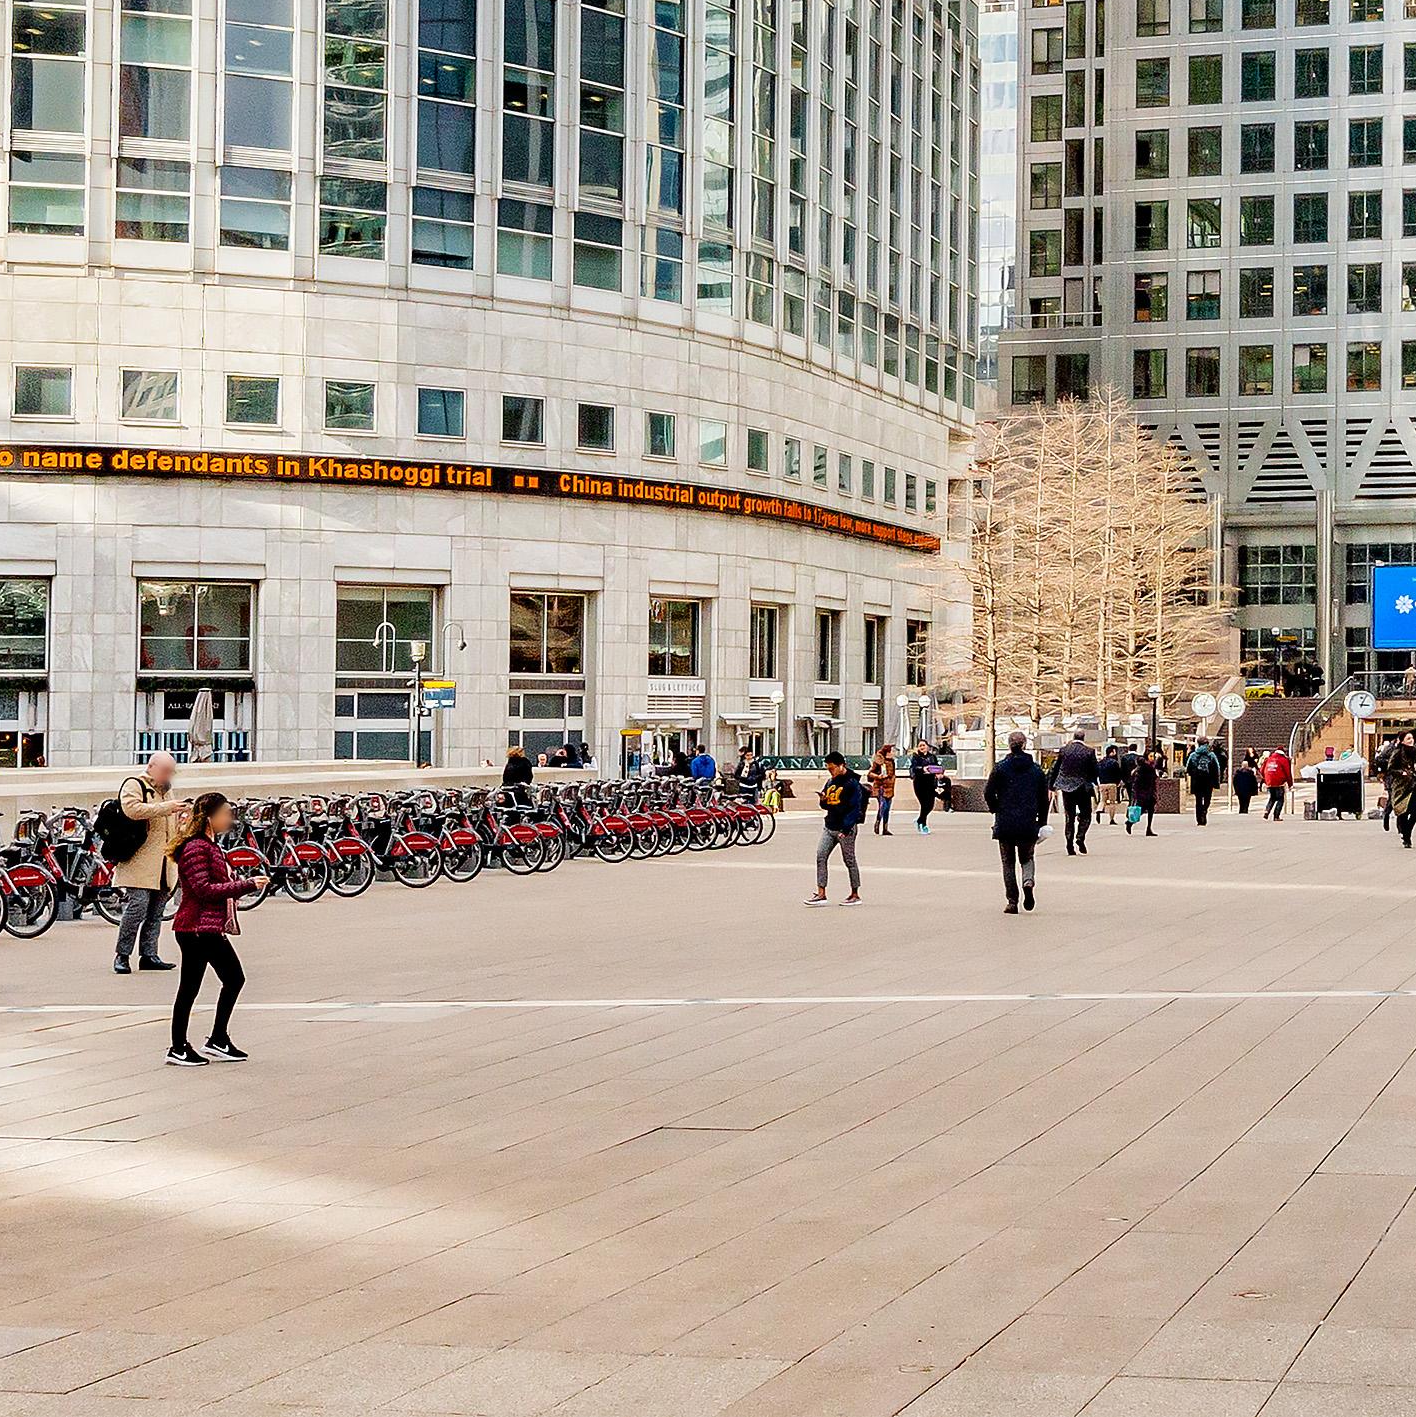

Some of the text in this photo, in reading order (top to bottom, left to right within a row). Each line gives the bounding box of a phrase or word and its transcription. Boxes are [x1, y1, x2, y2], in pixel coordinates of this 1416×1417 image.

[22, 451, 102, 469] name
[112, 450, 269, 476] defendants
[277, 456, 300, 477] in
[309, 458, 440, 487] Khashoggi
[447, 466, 492, 486] trial
[560, 474, 612, 496] China
[619, 479, 693, 504] industrial
[699, 489, 740, 512] output
[744, 498, 782, 516] growth
[758, 758, 841, 769] CANA
